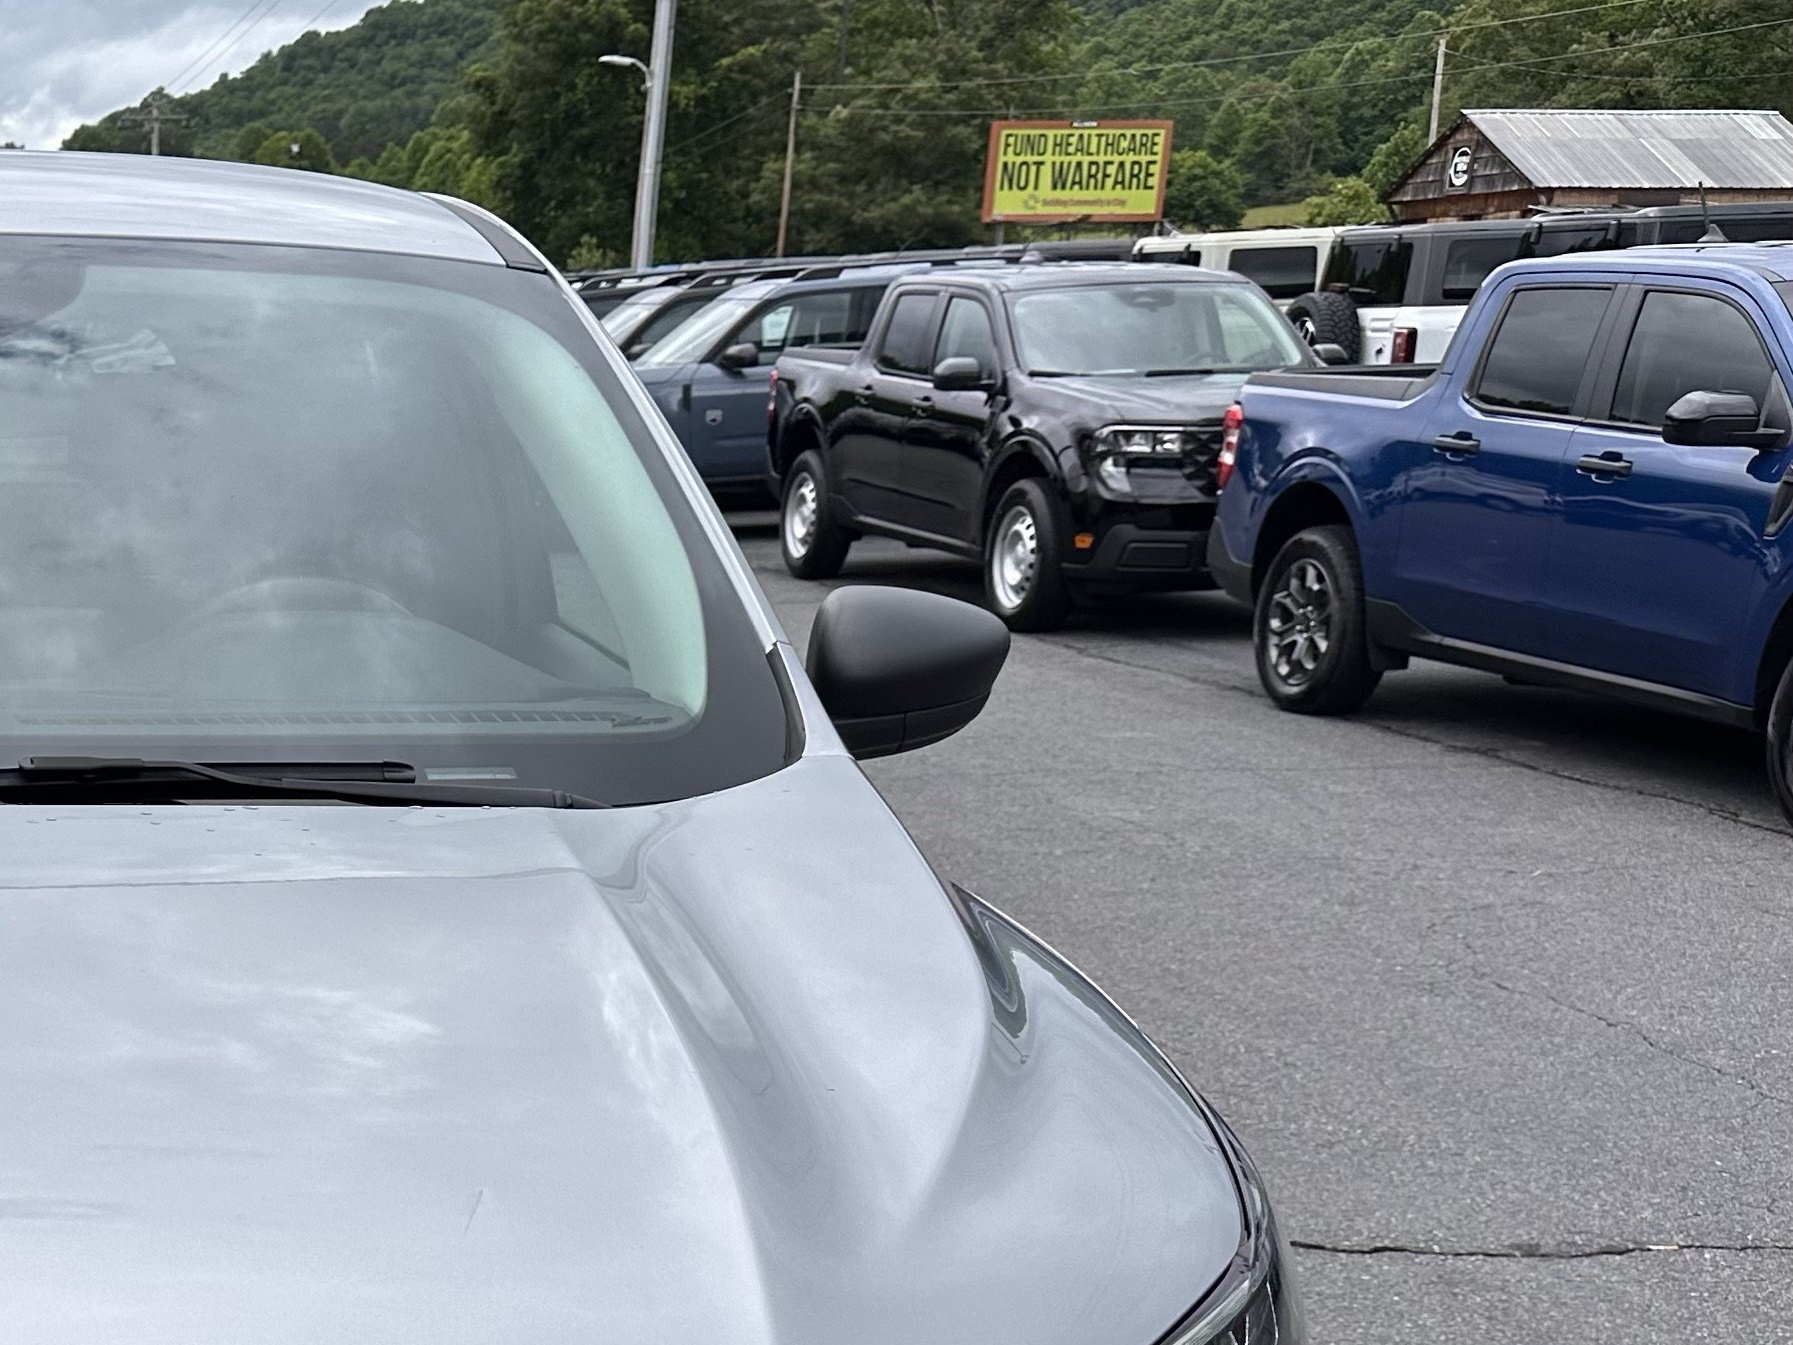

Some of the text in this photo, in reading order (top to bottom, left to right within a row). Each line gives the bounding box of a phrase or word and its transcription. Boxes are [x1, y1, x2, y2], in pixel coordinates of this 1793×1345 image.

[1002, 132, 1160, 157] FUND HEALTHCARE
[999, 160, 1158, 191] NOT WARFARE
